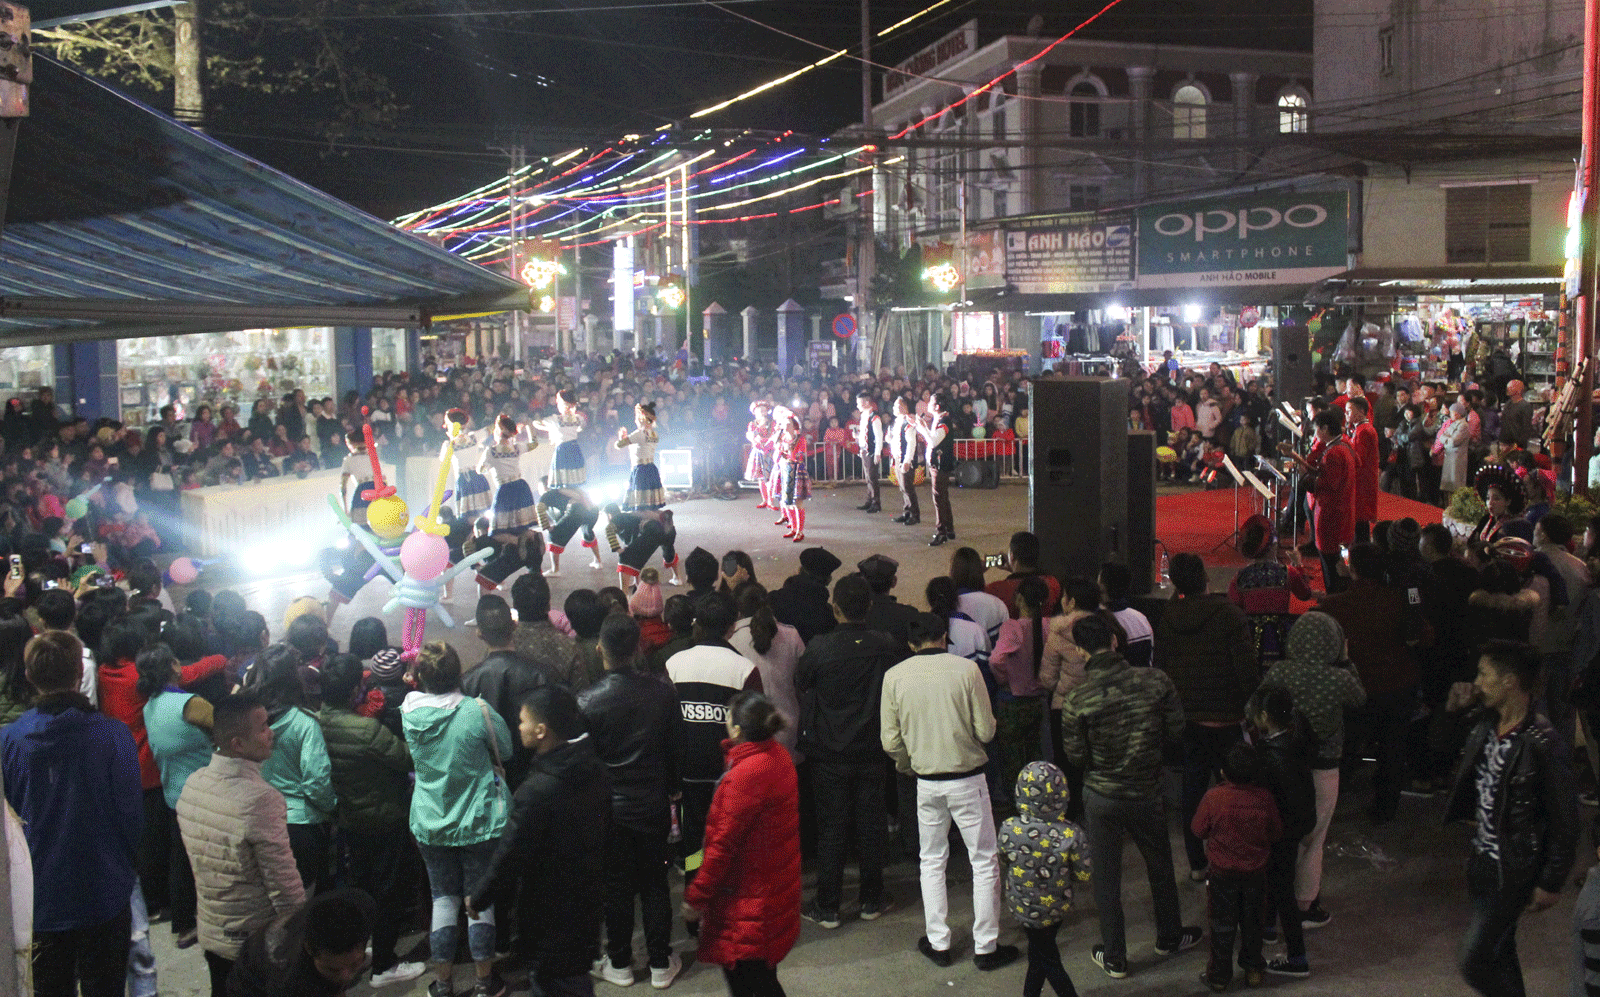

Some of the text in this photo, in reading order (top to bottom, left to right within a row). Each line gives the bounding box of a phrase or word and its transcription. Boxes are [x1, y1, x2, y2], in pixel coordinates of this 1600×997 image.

[1028, 231, 1063, 252] ANH
[1167, 245, 1313, 263] SMARTPHONE
[1200, 273, 1219, 282] ANH
[1245, 271, 1277, 280] MOBILE
